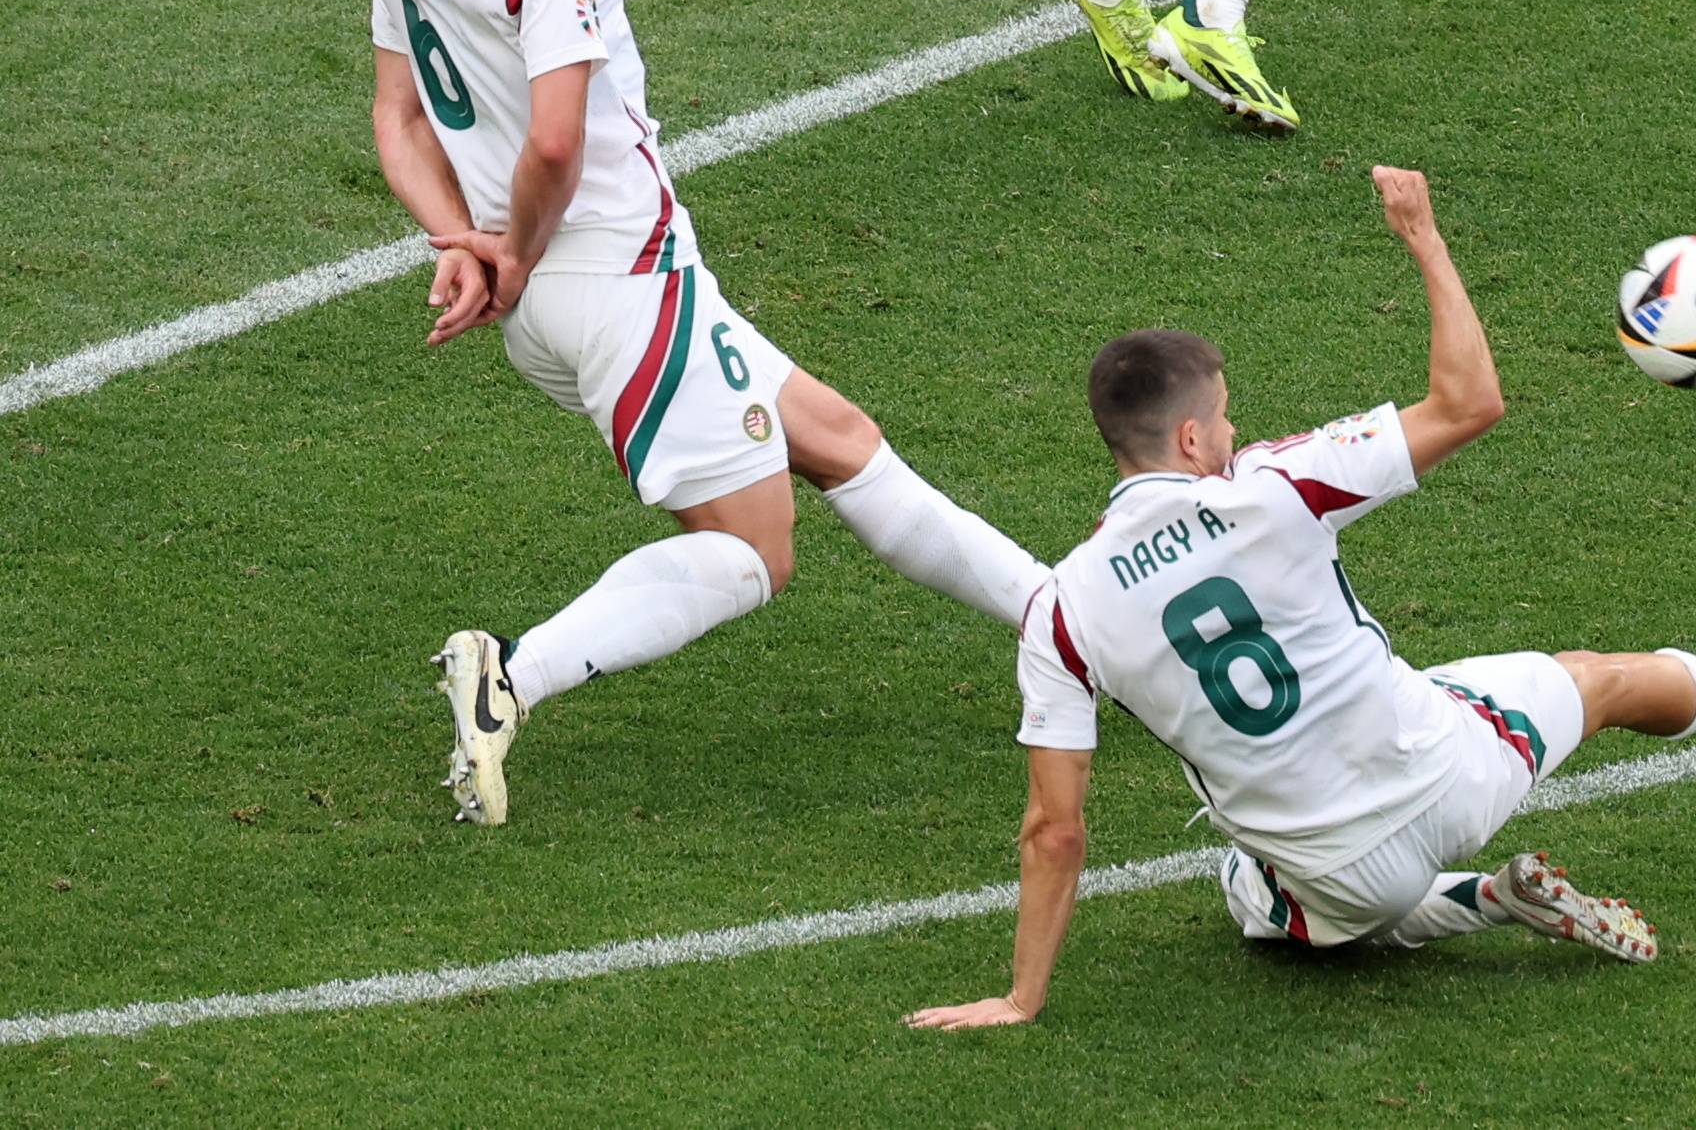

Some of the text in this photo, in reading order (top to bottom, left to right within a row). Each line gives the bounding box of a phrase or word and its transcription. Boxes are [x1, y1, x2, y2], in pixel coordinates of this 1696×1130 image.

[710, 321, 751, 392] 6
[1109, 499, 1236, 591] NAGY Á.
[1161, 575, 1302, 737] 8
